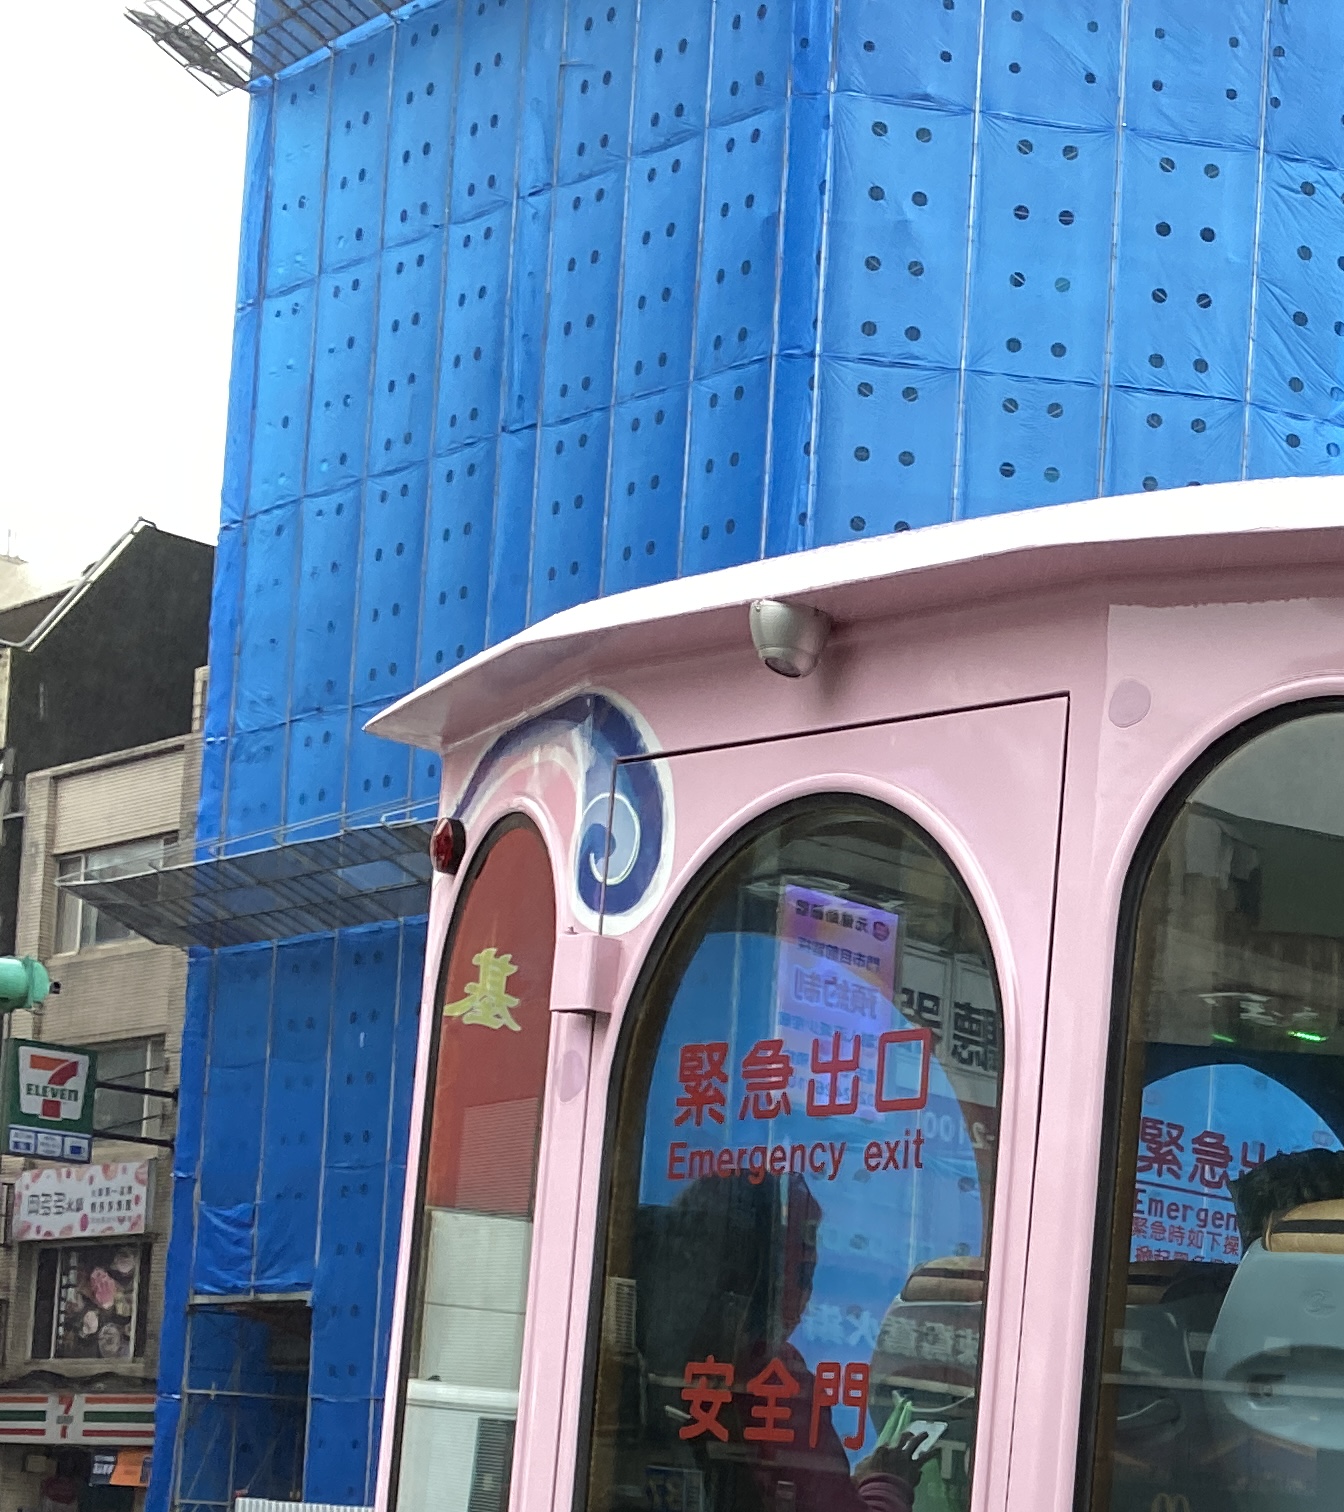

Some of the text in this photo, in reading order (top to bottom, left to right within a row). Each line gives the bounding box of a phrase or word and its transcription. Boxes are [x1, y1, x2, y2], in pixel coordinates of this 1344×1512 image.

[443, 946, 521, 1032] 基
[673, 1027, 932, 1127] 緊急出口
[667, 1128, 925, 1185] Emergency exit
[679, 1355, 871, 1451] 安全門
